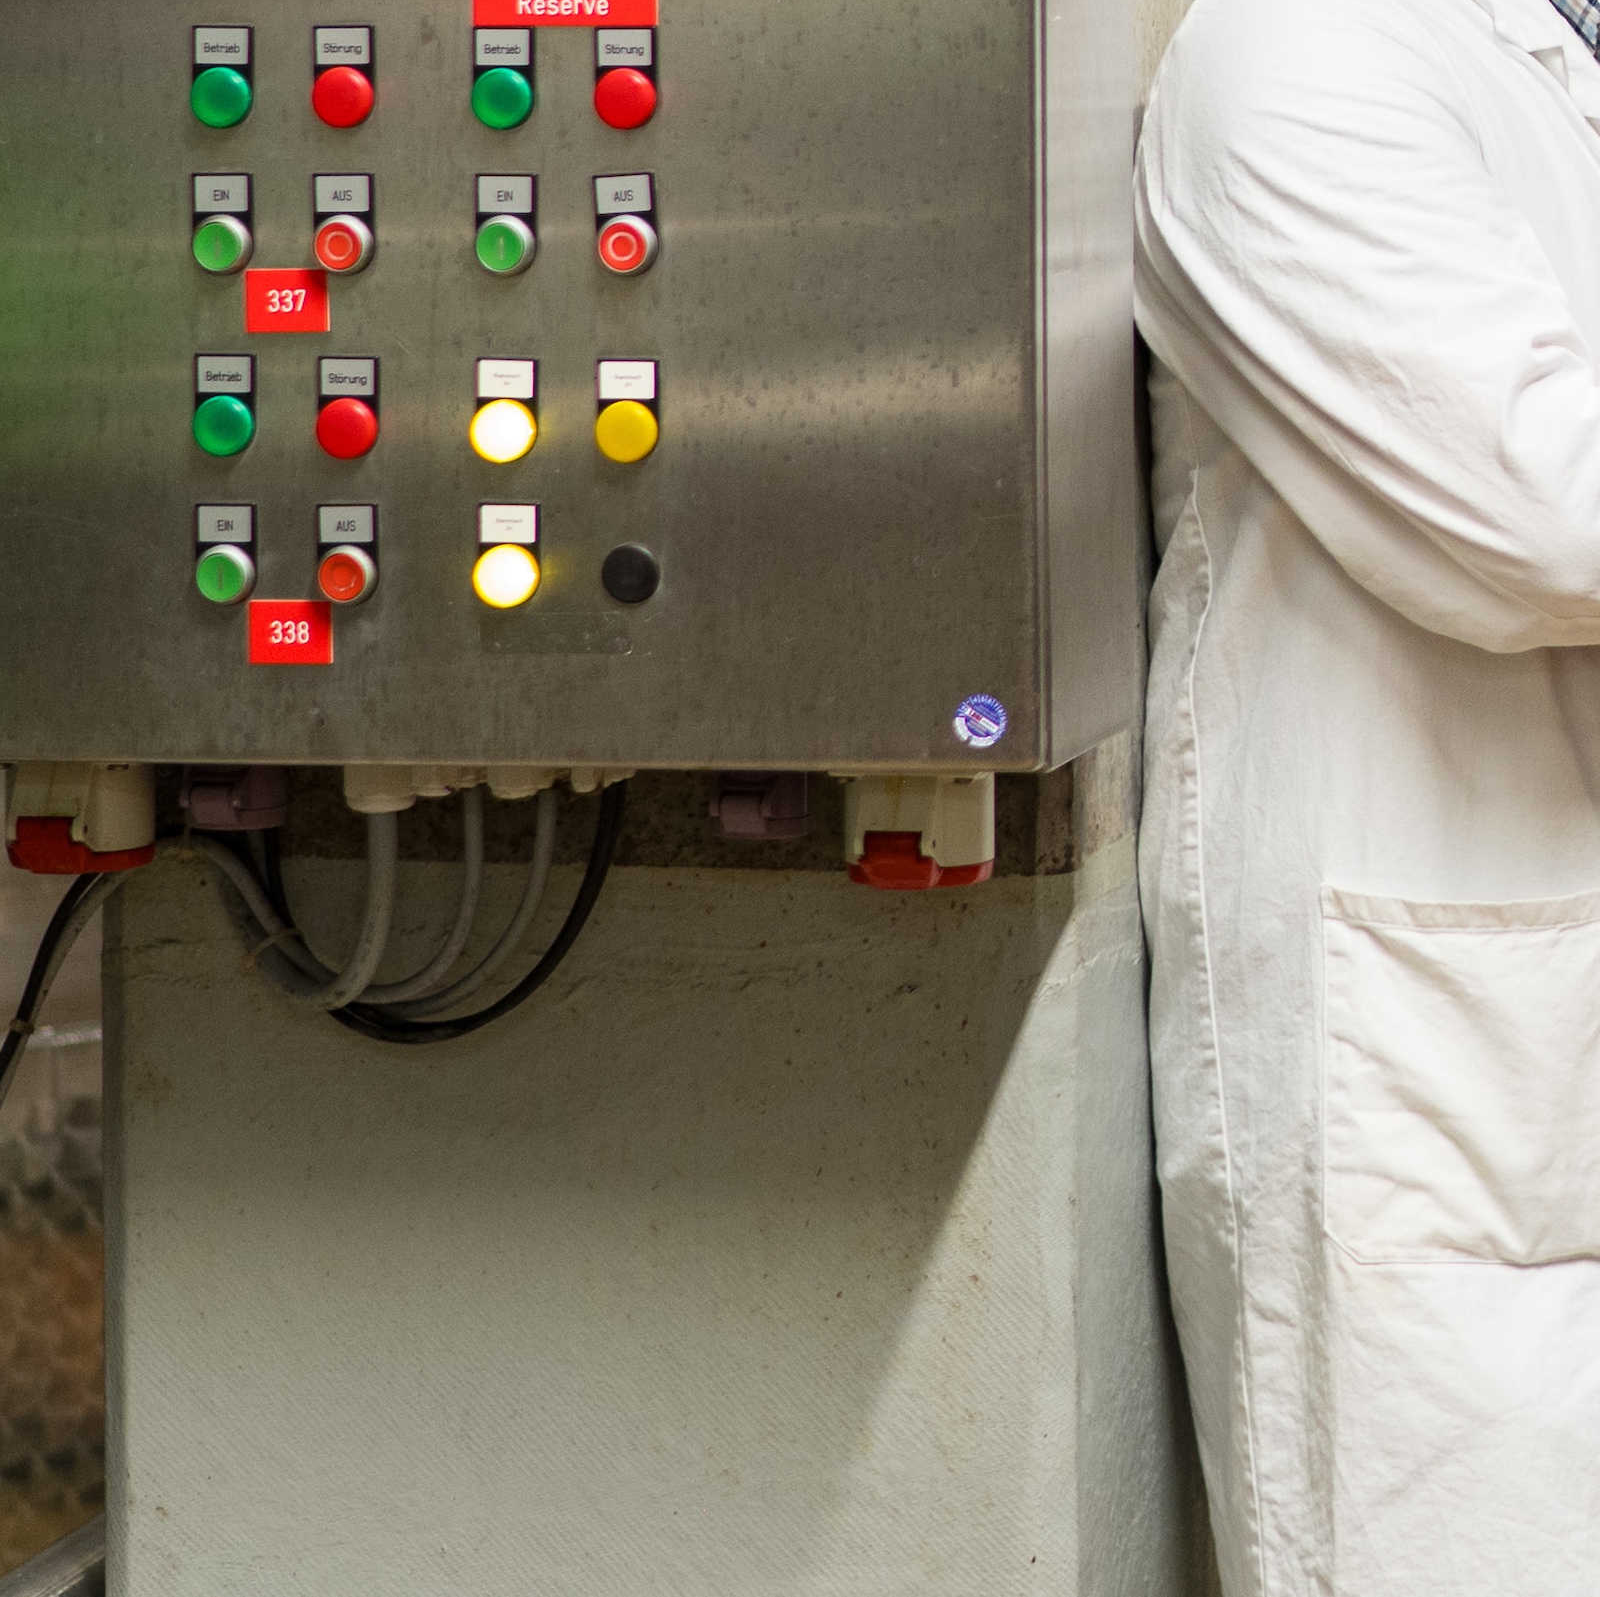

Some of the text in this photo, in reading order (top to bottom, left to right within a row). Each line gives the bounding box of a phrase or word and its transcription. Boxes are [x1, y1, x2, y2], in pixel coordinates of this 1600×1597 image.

[203, 42, 241, 54] Betrieb
[323, 42, 363, 55] Störung
[484, 43, 522, 55] Betrieb
[605, 42, 645, 56] Störung
[212, 189, 230, 202] EIN
[331, 189, 353, 202] AUS
[496, 190, 514, 203] EIN
[614, 190, 635, 203] AUS
[266, 288, 307, 313] 337
[205, 370, 243, 382] Betrieb
[328, 372, 368, 386] Störung
[216, 519, 234, 532] EIN
[335, 519, 357, 532] AUS
[269, 620, 310, 644] 338
